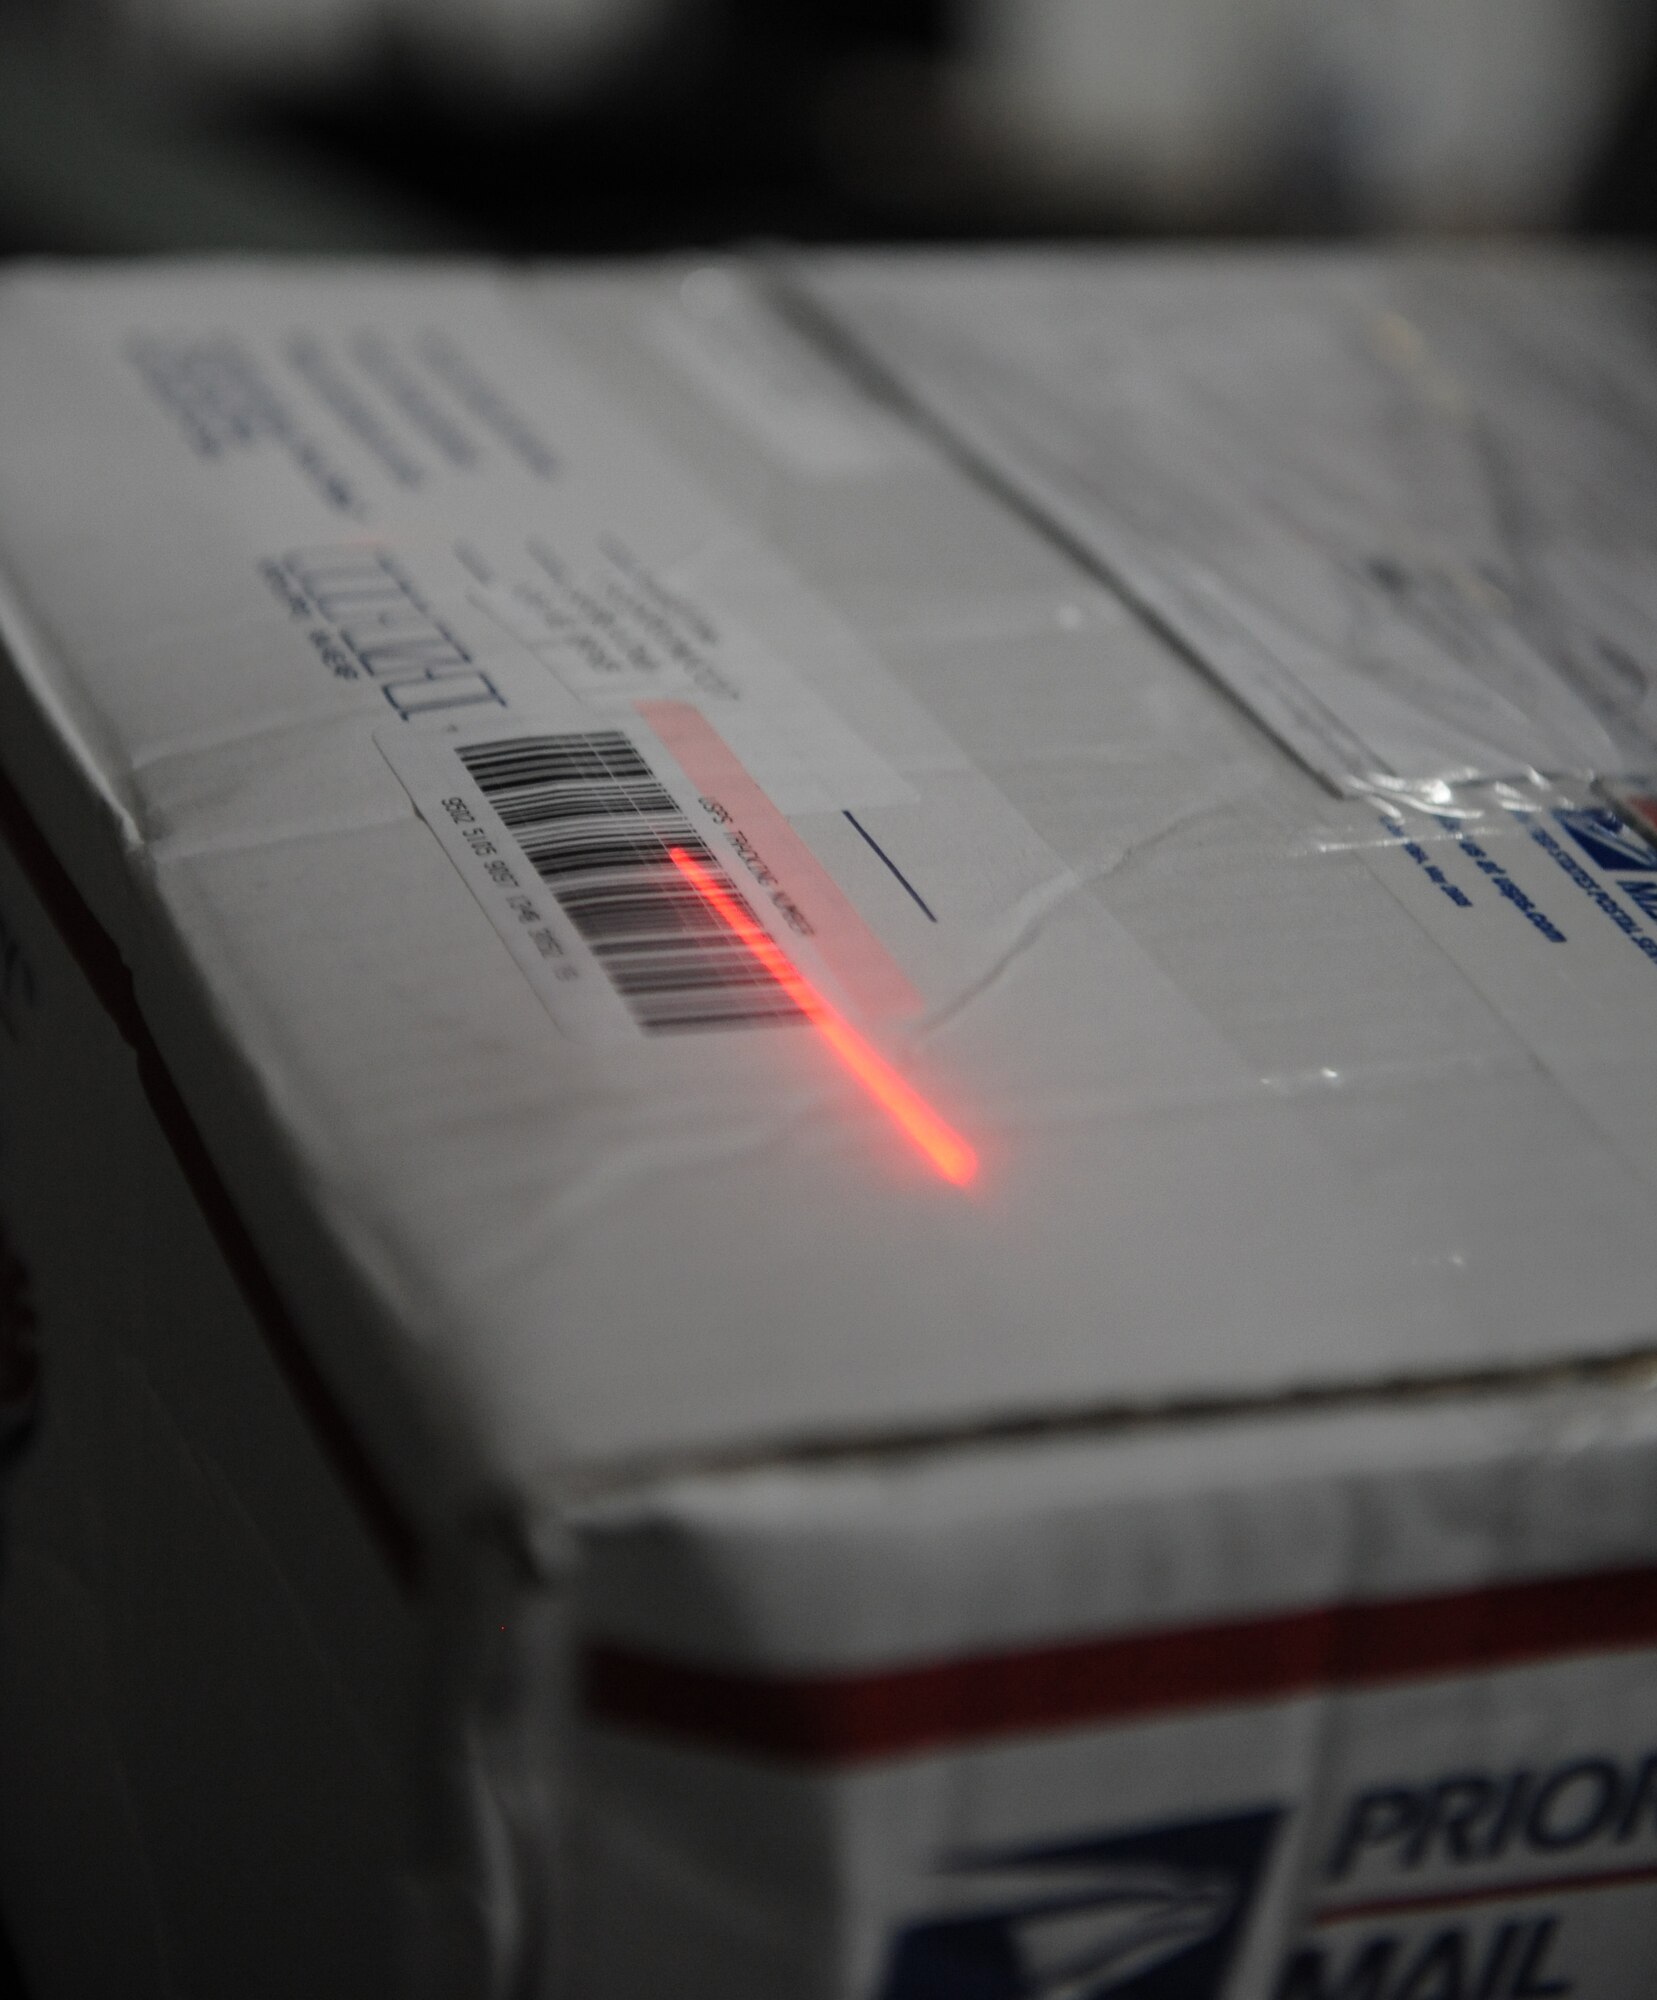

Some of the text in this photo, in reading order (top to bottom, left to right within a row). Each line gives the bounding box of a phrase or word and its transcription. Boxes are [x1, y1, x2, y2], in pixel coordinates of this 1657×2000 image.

[698, 797, 816, 937] USPS TRACKING NUMBER
[1273, 1914, 1571, 2000] MAIL
